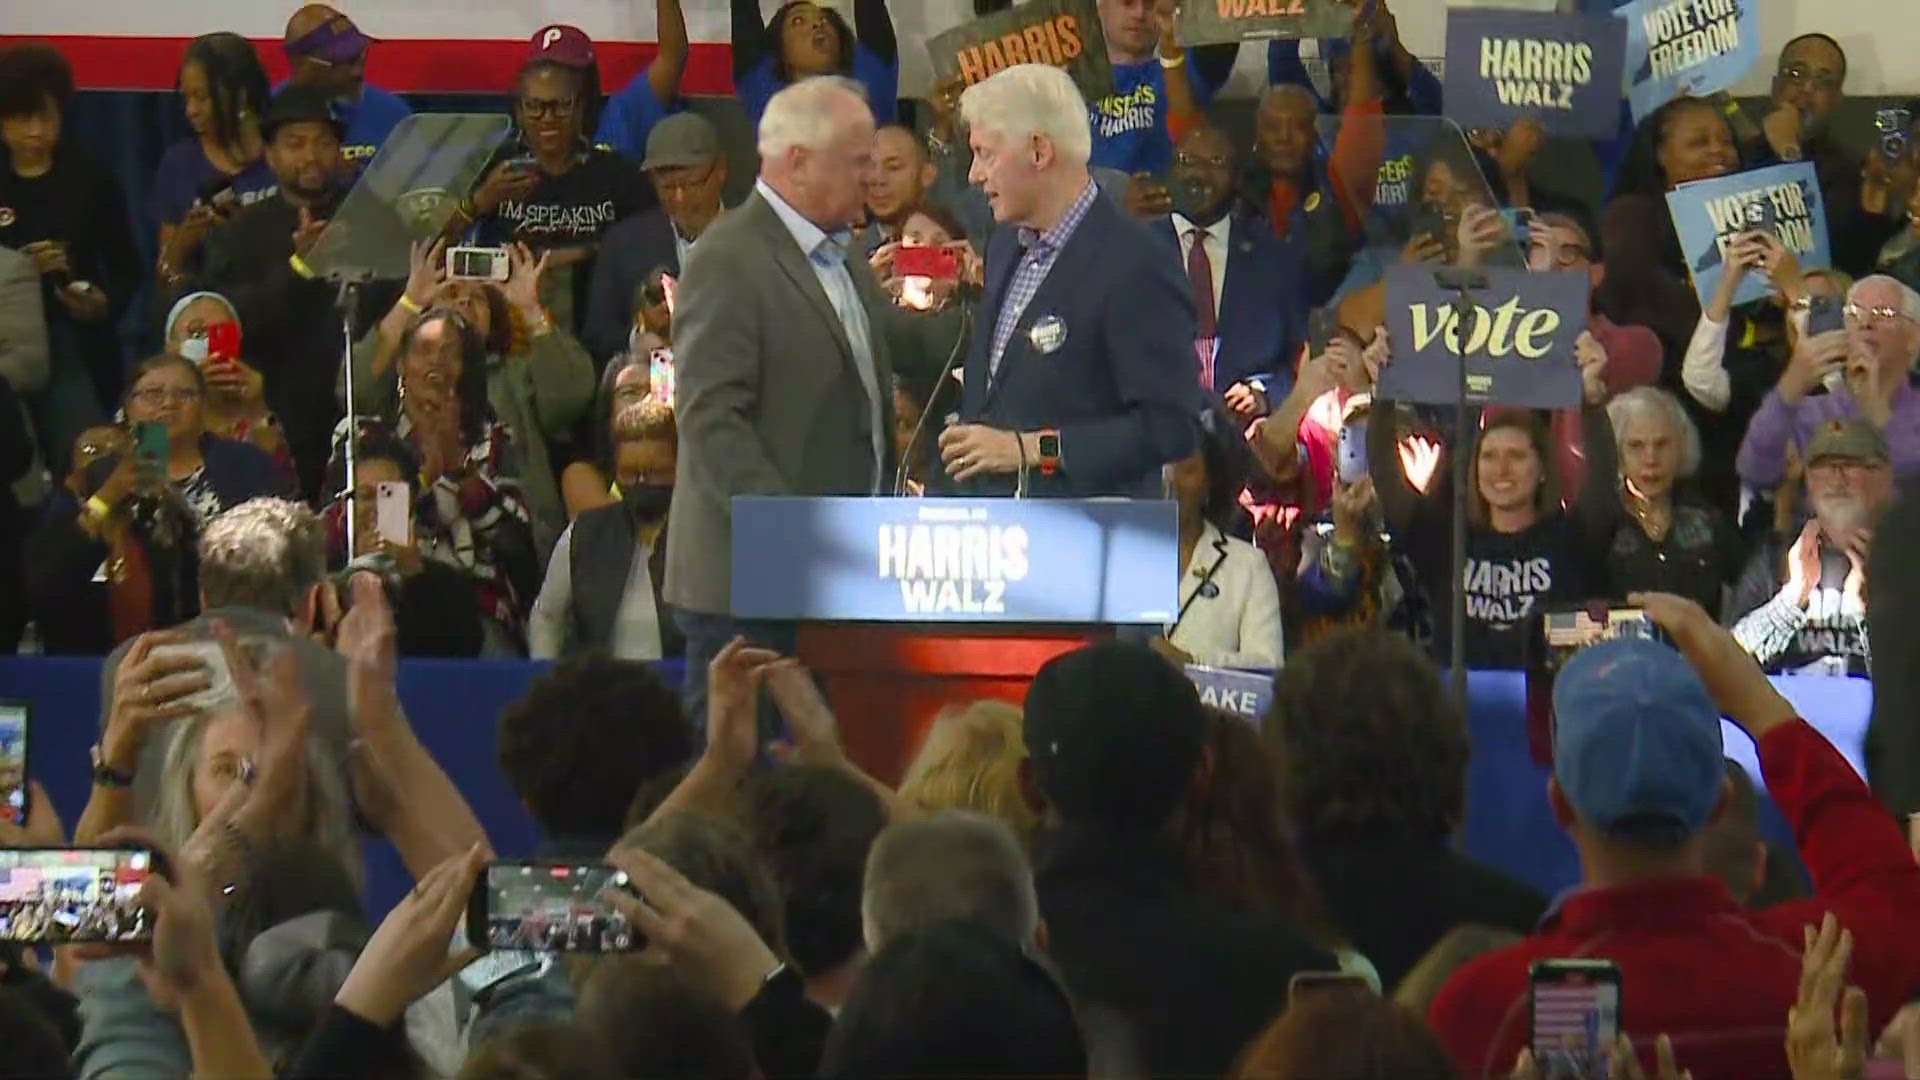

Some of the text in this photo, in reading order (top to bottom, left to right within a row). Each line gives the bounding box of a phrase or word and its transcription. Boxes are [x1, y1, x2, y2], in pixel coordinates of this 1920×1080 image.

[543, 28, 562, 50] P
[1643, 0, 1694, 47] VOTE
[957, 14, 1082, 86] HARRIS
[1480, 37, 1592, 84] HARRIS
[1649, 14, 1738, 80] FREEDOM
[1495, 80, 1574, 109] WALZ
[525, 200, 615, 226] SPEAKING
[1767, 182, 1808, 219] FOR
[1716, 217, 1816, 262] FDOM
[1409, 295, 1560, 358] vote
[878, 524, 1028, 580] HARRIS
[901, 578, 1006, 613] WALZ
[1194, 682, 1257, 715] AKE
